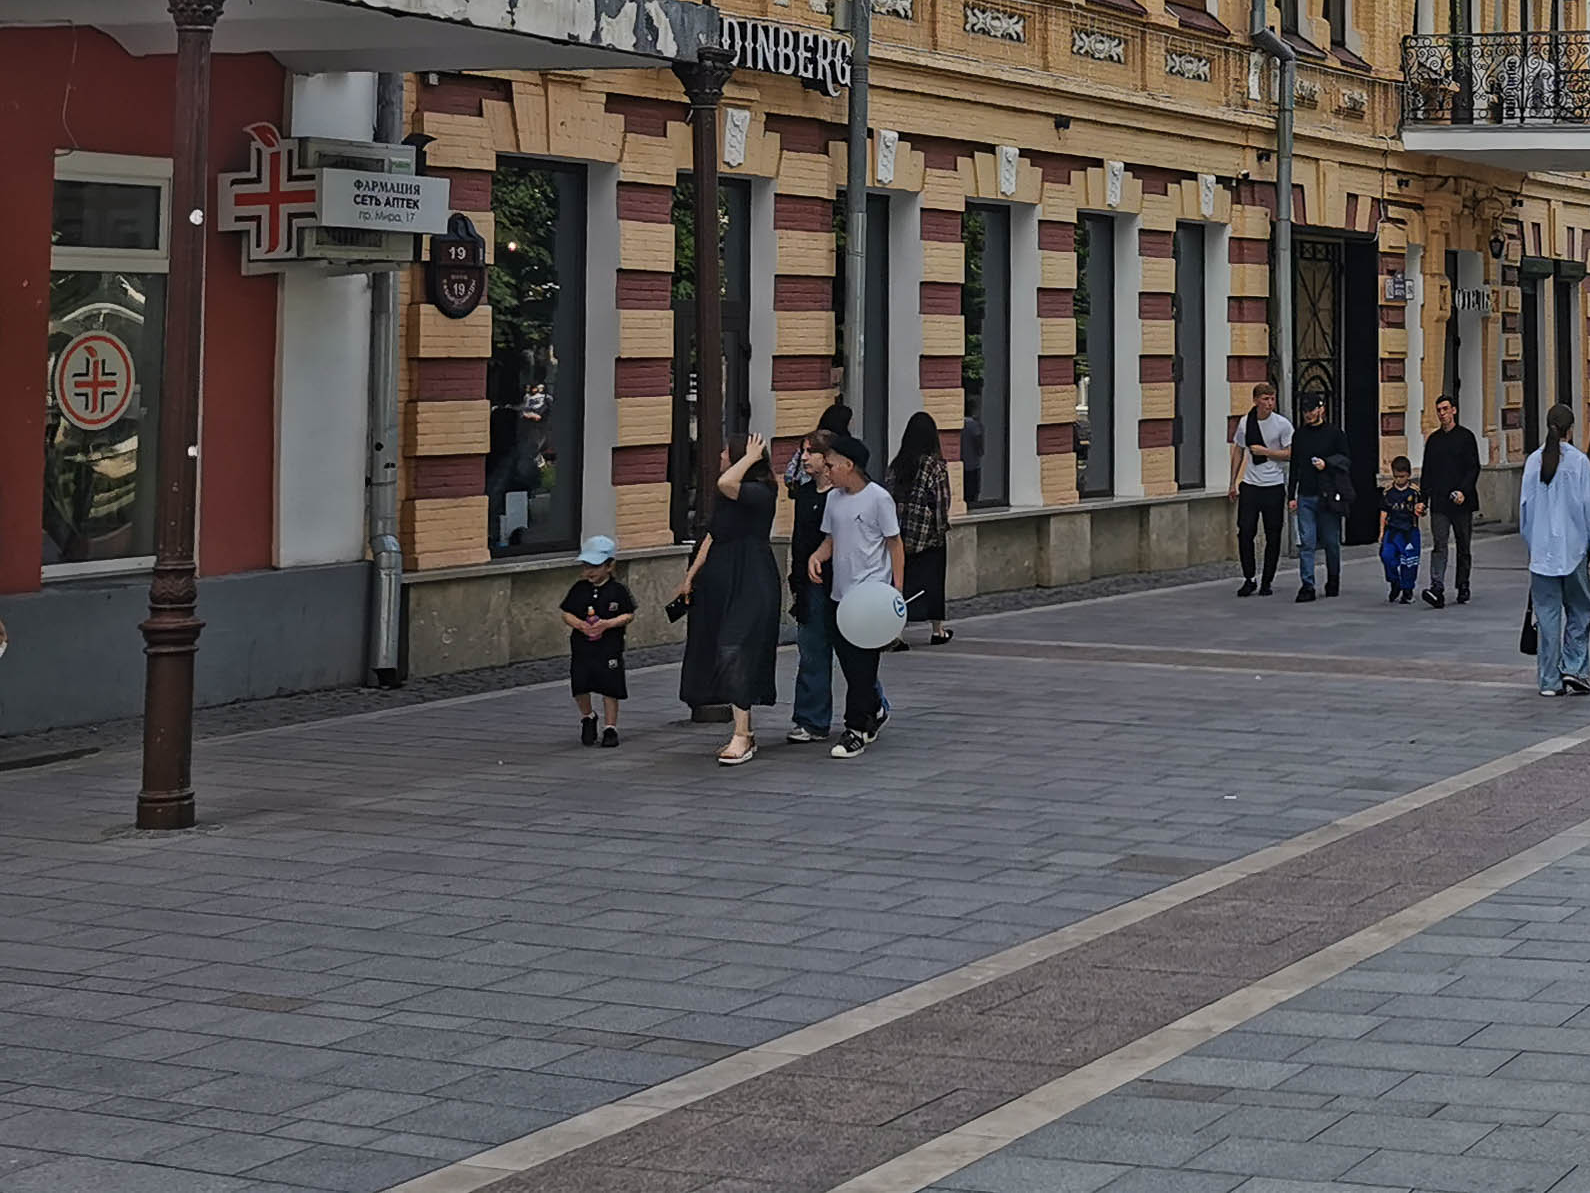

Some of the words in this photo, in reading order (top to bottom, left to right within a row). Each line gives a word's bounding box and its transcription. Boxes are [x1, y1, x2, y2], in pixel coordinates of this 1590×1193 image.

[353, 179, 421, 196] ФАРМАЦИЯ
[353, 194, 382, 207] СЕТЬ
[384, 196, 420, 210] АПТЕК
[406, 212, 416, 223] 17
[448, 246, 467, 260] 19
[452, 282, 466, 296] 19
